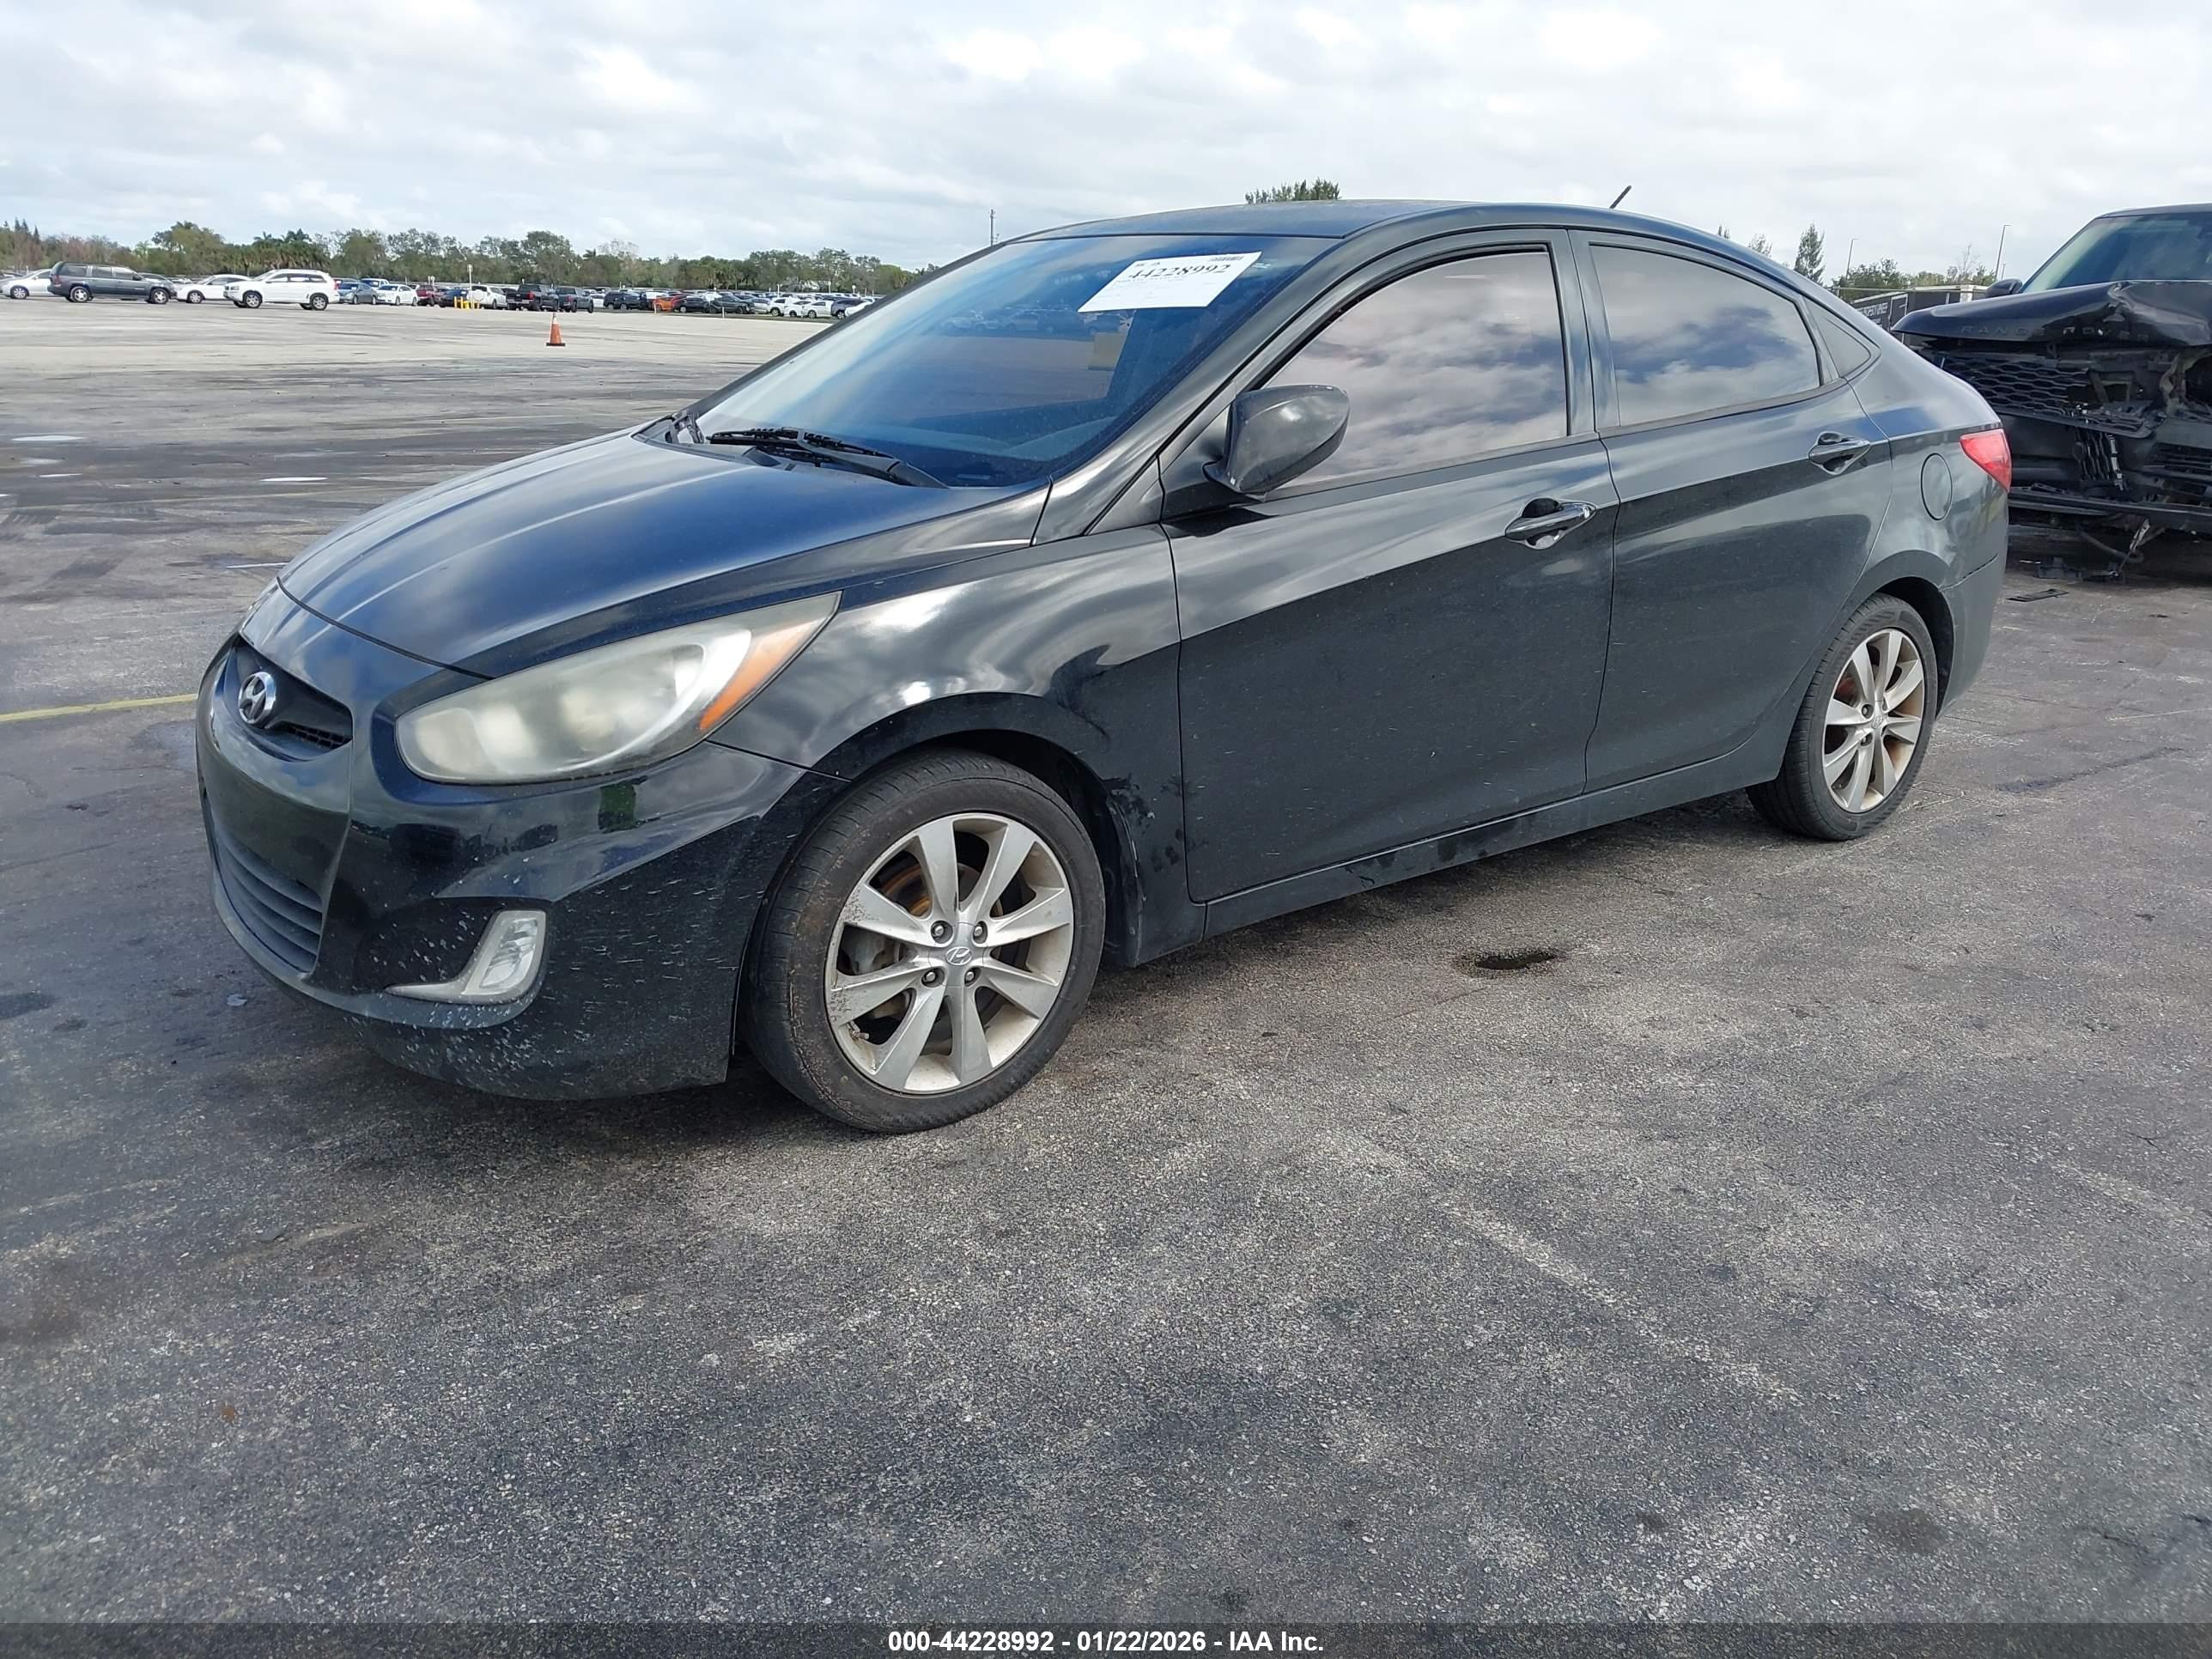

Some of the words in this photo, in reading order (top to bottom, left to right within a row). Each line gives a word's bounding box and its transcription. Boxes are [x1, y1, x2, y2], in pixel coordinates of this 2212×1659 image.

[1128, 264, 1231, 279] 44228992
[1960, 325, 2046, 337] RANGE
[2062, 326, 2150, 343] ROVER
